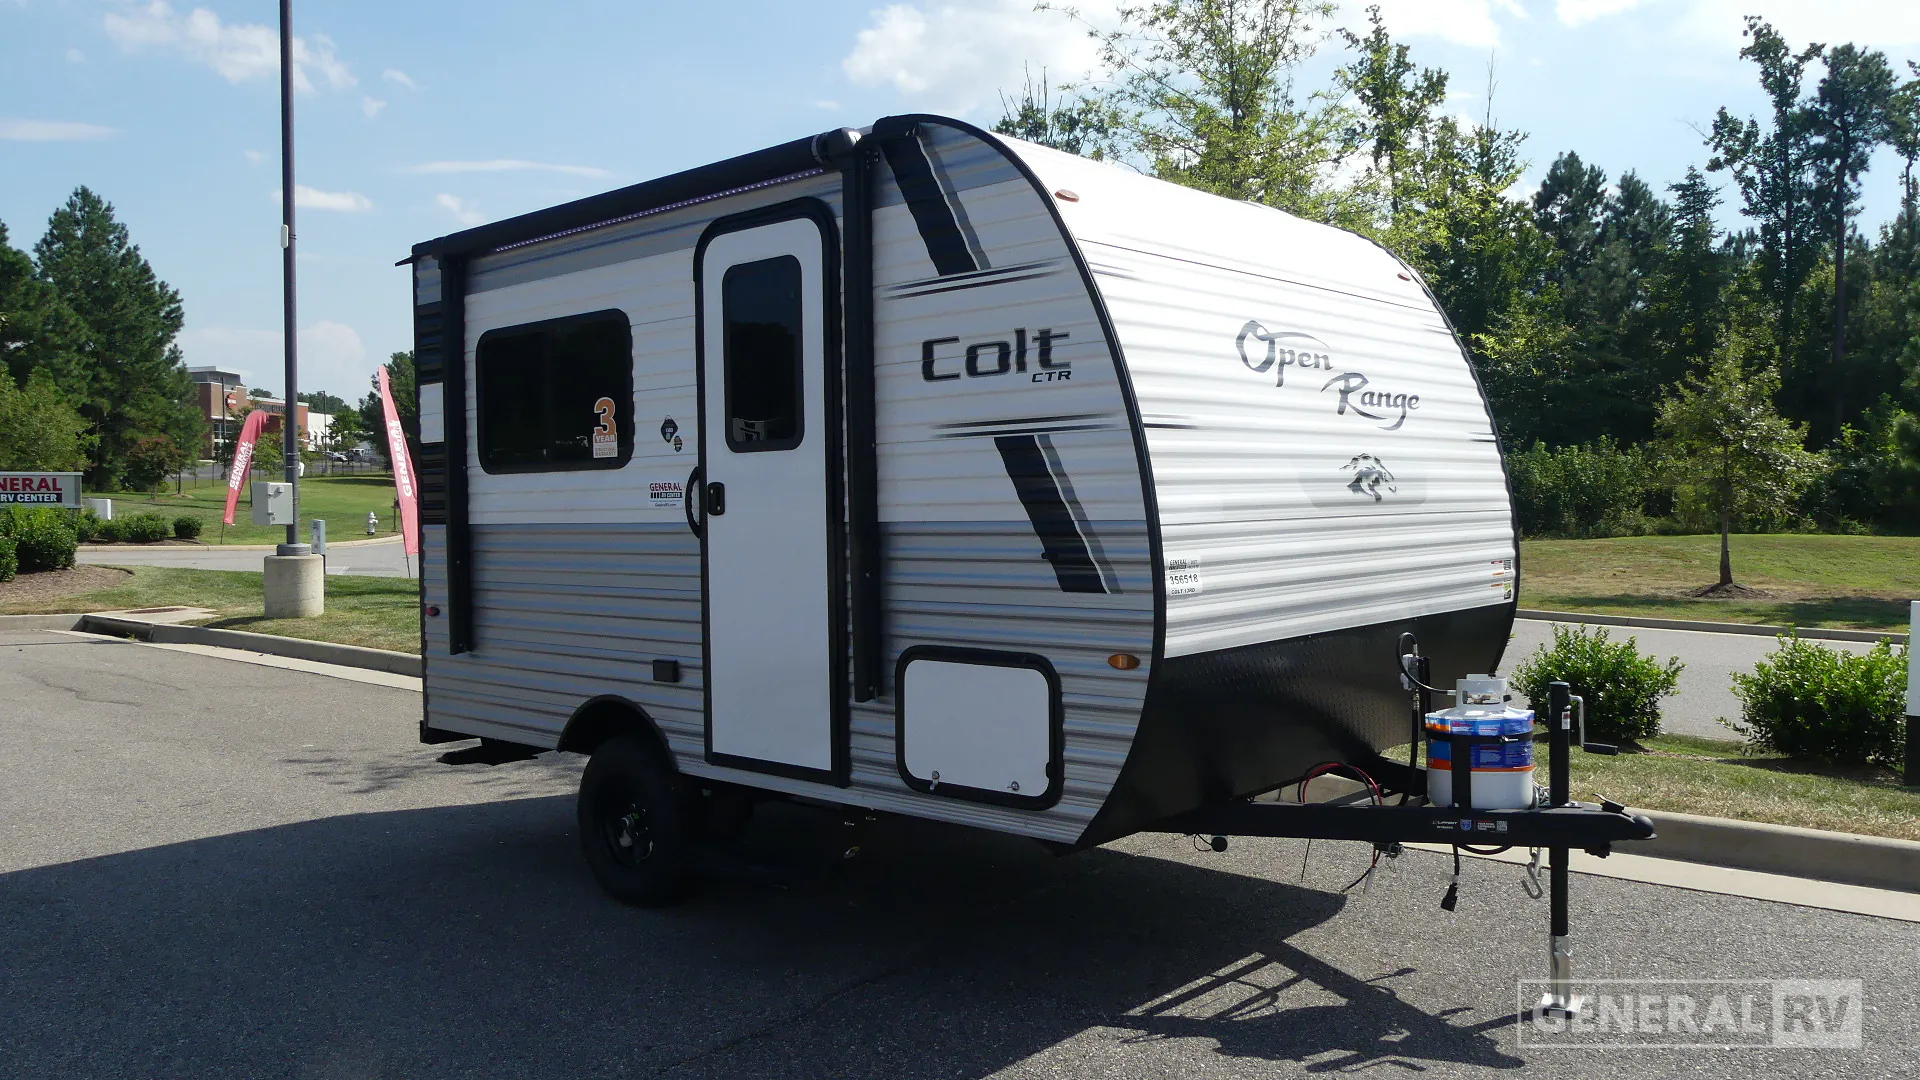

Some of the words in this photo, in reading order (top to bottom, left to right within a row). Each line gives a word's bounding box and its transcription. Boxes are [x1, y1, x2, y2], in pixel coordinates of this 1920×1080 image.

[922, 327, 1072, 383] Colt
[1235, 319, 1334, 388] Open
[1031, 370, 1072, 383] CTR
[1320, 372, 1420, 431] Range
[594, 397, 617, 436] 3
[596, 435, 616, 443] YEAR
[649, 482, 683, 491] GENERAL
[0, 493, 15, 502] RV
[17, 493, 57, 502] CENTER
[1169, 573, 1199, 585] 356518
